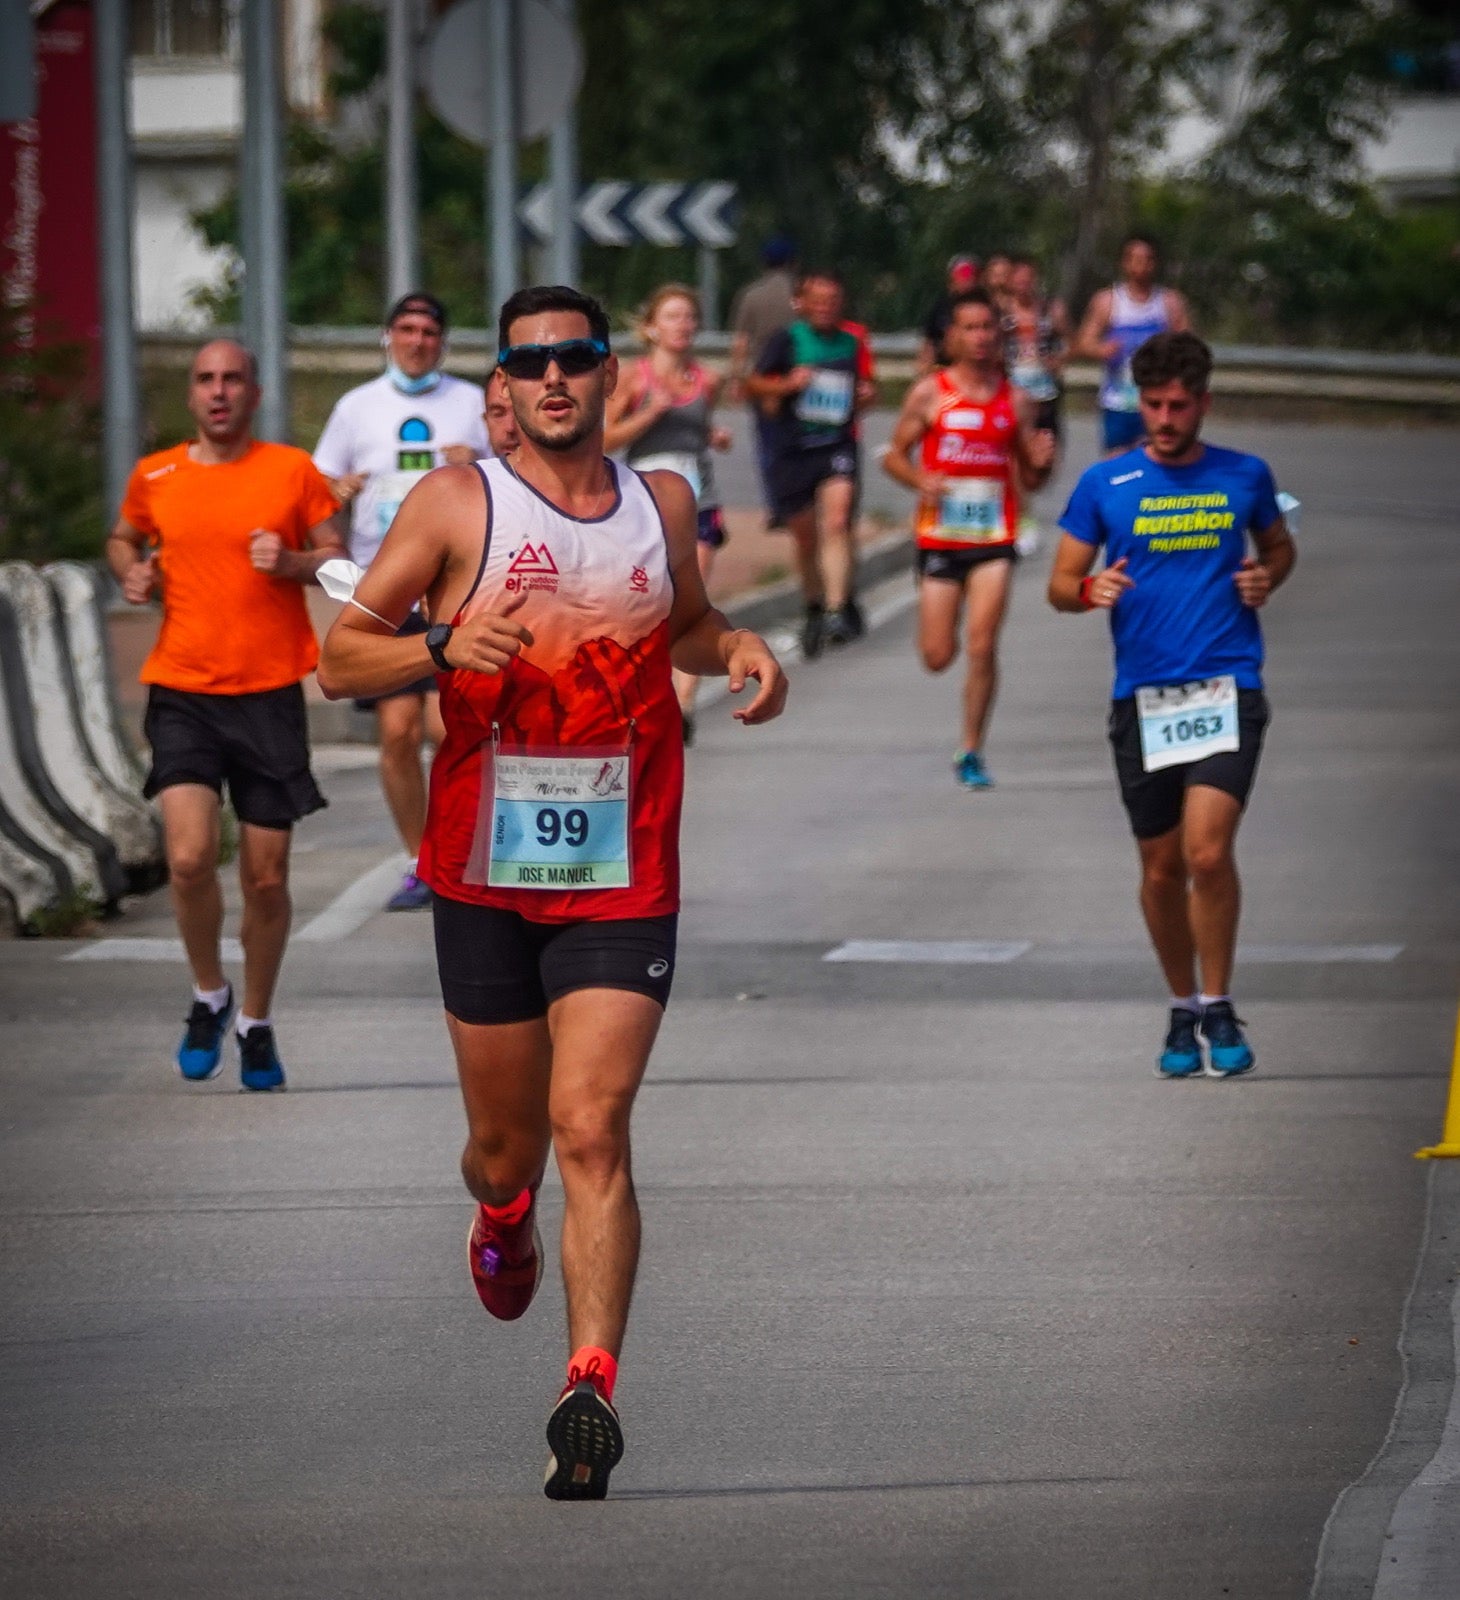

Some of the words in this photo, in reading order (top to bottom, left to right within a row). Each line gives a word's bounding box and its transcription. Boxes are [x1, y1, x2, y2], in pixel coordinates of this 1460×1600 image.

[1133, 509, 1235, 536] RUISEÑOR
[530, 576, 560, 585] outdoor
[1161, 715, 1224, 743] 1063
[536, 808, 589, 847] 99
[517, 867, 545, 884] JOSE
[547, 867, 596, 884] MANUEL
